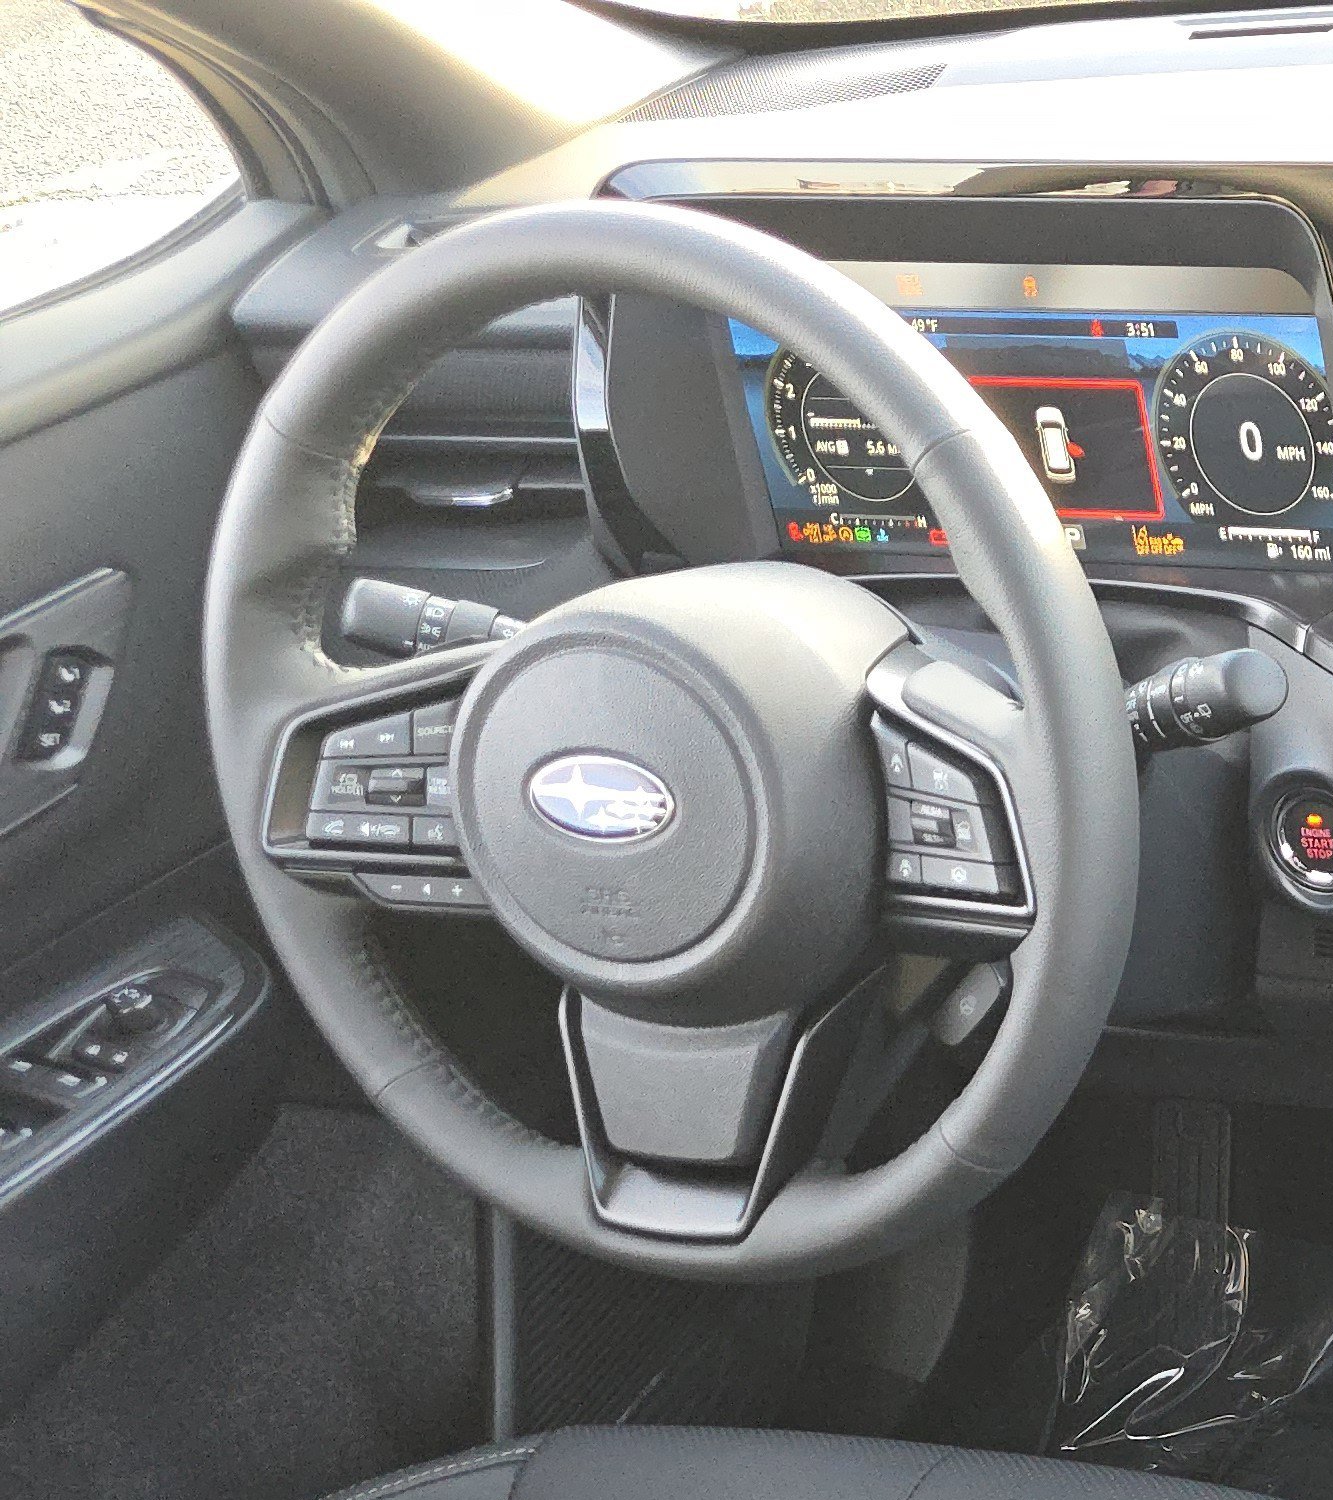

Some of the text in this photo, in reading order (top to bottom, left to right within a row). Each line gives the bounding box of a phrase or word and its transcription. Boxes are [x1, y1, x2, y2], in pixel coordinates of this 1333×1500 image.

[1126, 323, 1155, 337] 3:51
[1230, 349, 1243, 361] 80
[816, 440, 835, 453] AVG
[866, 441, 885, 454] 5.6
[1173, 437, 1186, 450] 20
[1240, 421, 1263, 461] 0
[1277, 446, 1305, 461] MPH
[1190, 502, 1214, 516] MPH
[1300, 827, 1331, 838] ENGINE
[1300, 838, 1333, 849] START
[1306, 848, 1333, 860] STOP
